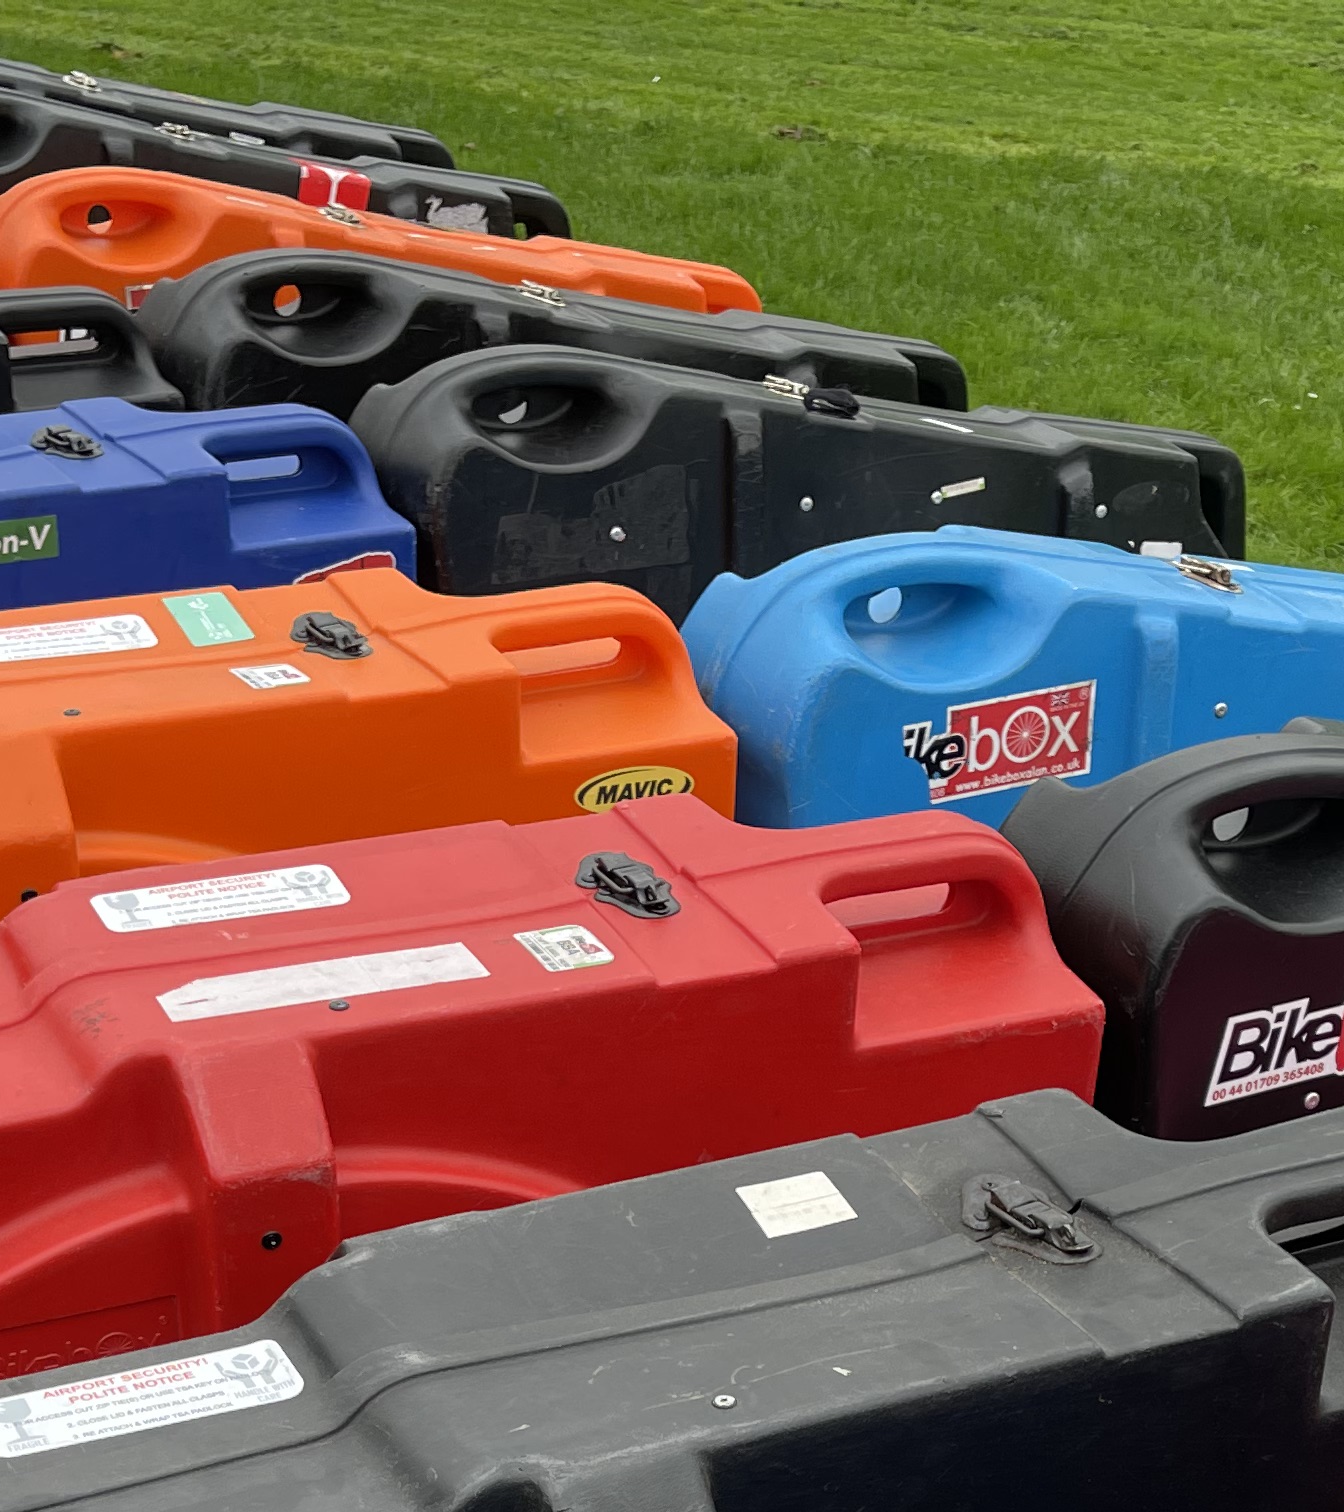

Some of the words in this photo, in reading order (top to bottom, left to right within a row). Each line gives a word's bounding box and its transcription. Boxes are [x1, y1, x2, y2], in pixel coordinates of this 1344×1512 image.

[595, 779, 674, 805] MAVIC
[146, 882, 206, 894] AIRPORT
[166, 888, 215, 899] POLITE
[215, 881, 266, 892] NOTICE
[1212, 1087, 1226, 1101] 00
[1229, 1085, 1244, 1097] 44
[1246, 1074, 1280, 1093] 01709
[1282, 1062, 1325, 1084] 365408
[40, 1377, 117, 1398] AIRPORT
[118, 1357, 209, 1381] SECURITY!
[65, 1385, 130, 1404] POLITE
[130, 1371, 196, 1390] NOTICE
[33, 1410, 74, 1423] ACCESS
[73, 1405, 95, 1414] CUT
[138, 1392, 155, 1400] OR
[154, 1388, 174, 1396] USE
[192, 1380, 213, 1388] KEY
[212, 1376, 229, 1384] ON
[75, 1415, 109, 1427] CLOSE
[107, 1411, 126, 1419] LID
[133, 1401, 171, 1414] FASTEN
[168, 1397, 189, 1406] ALL
[187, 1389, 225, 1402] CLASPS
[95, 1421, 135, 1435] ATTACH
[141, 1413, 172, 1425] WRAP
[169, 1409, 191, 1419] TSA
[188, 1399, 233, 1414] PADLOCK
